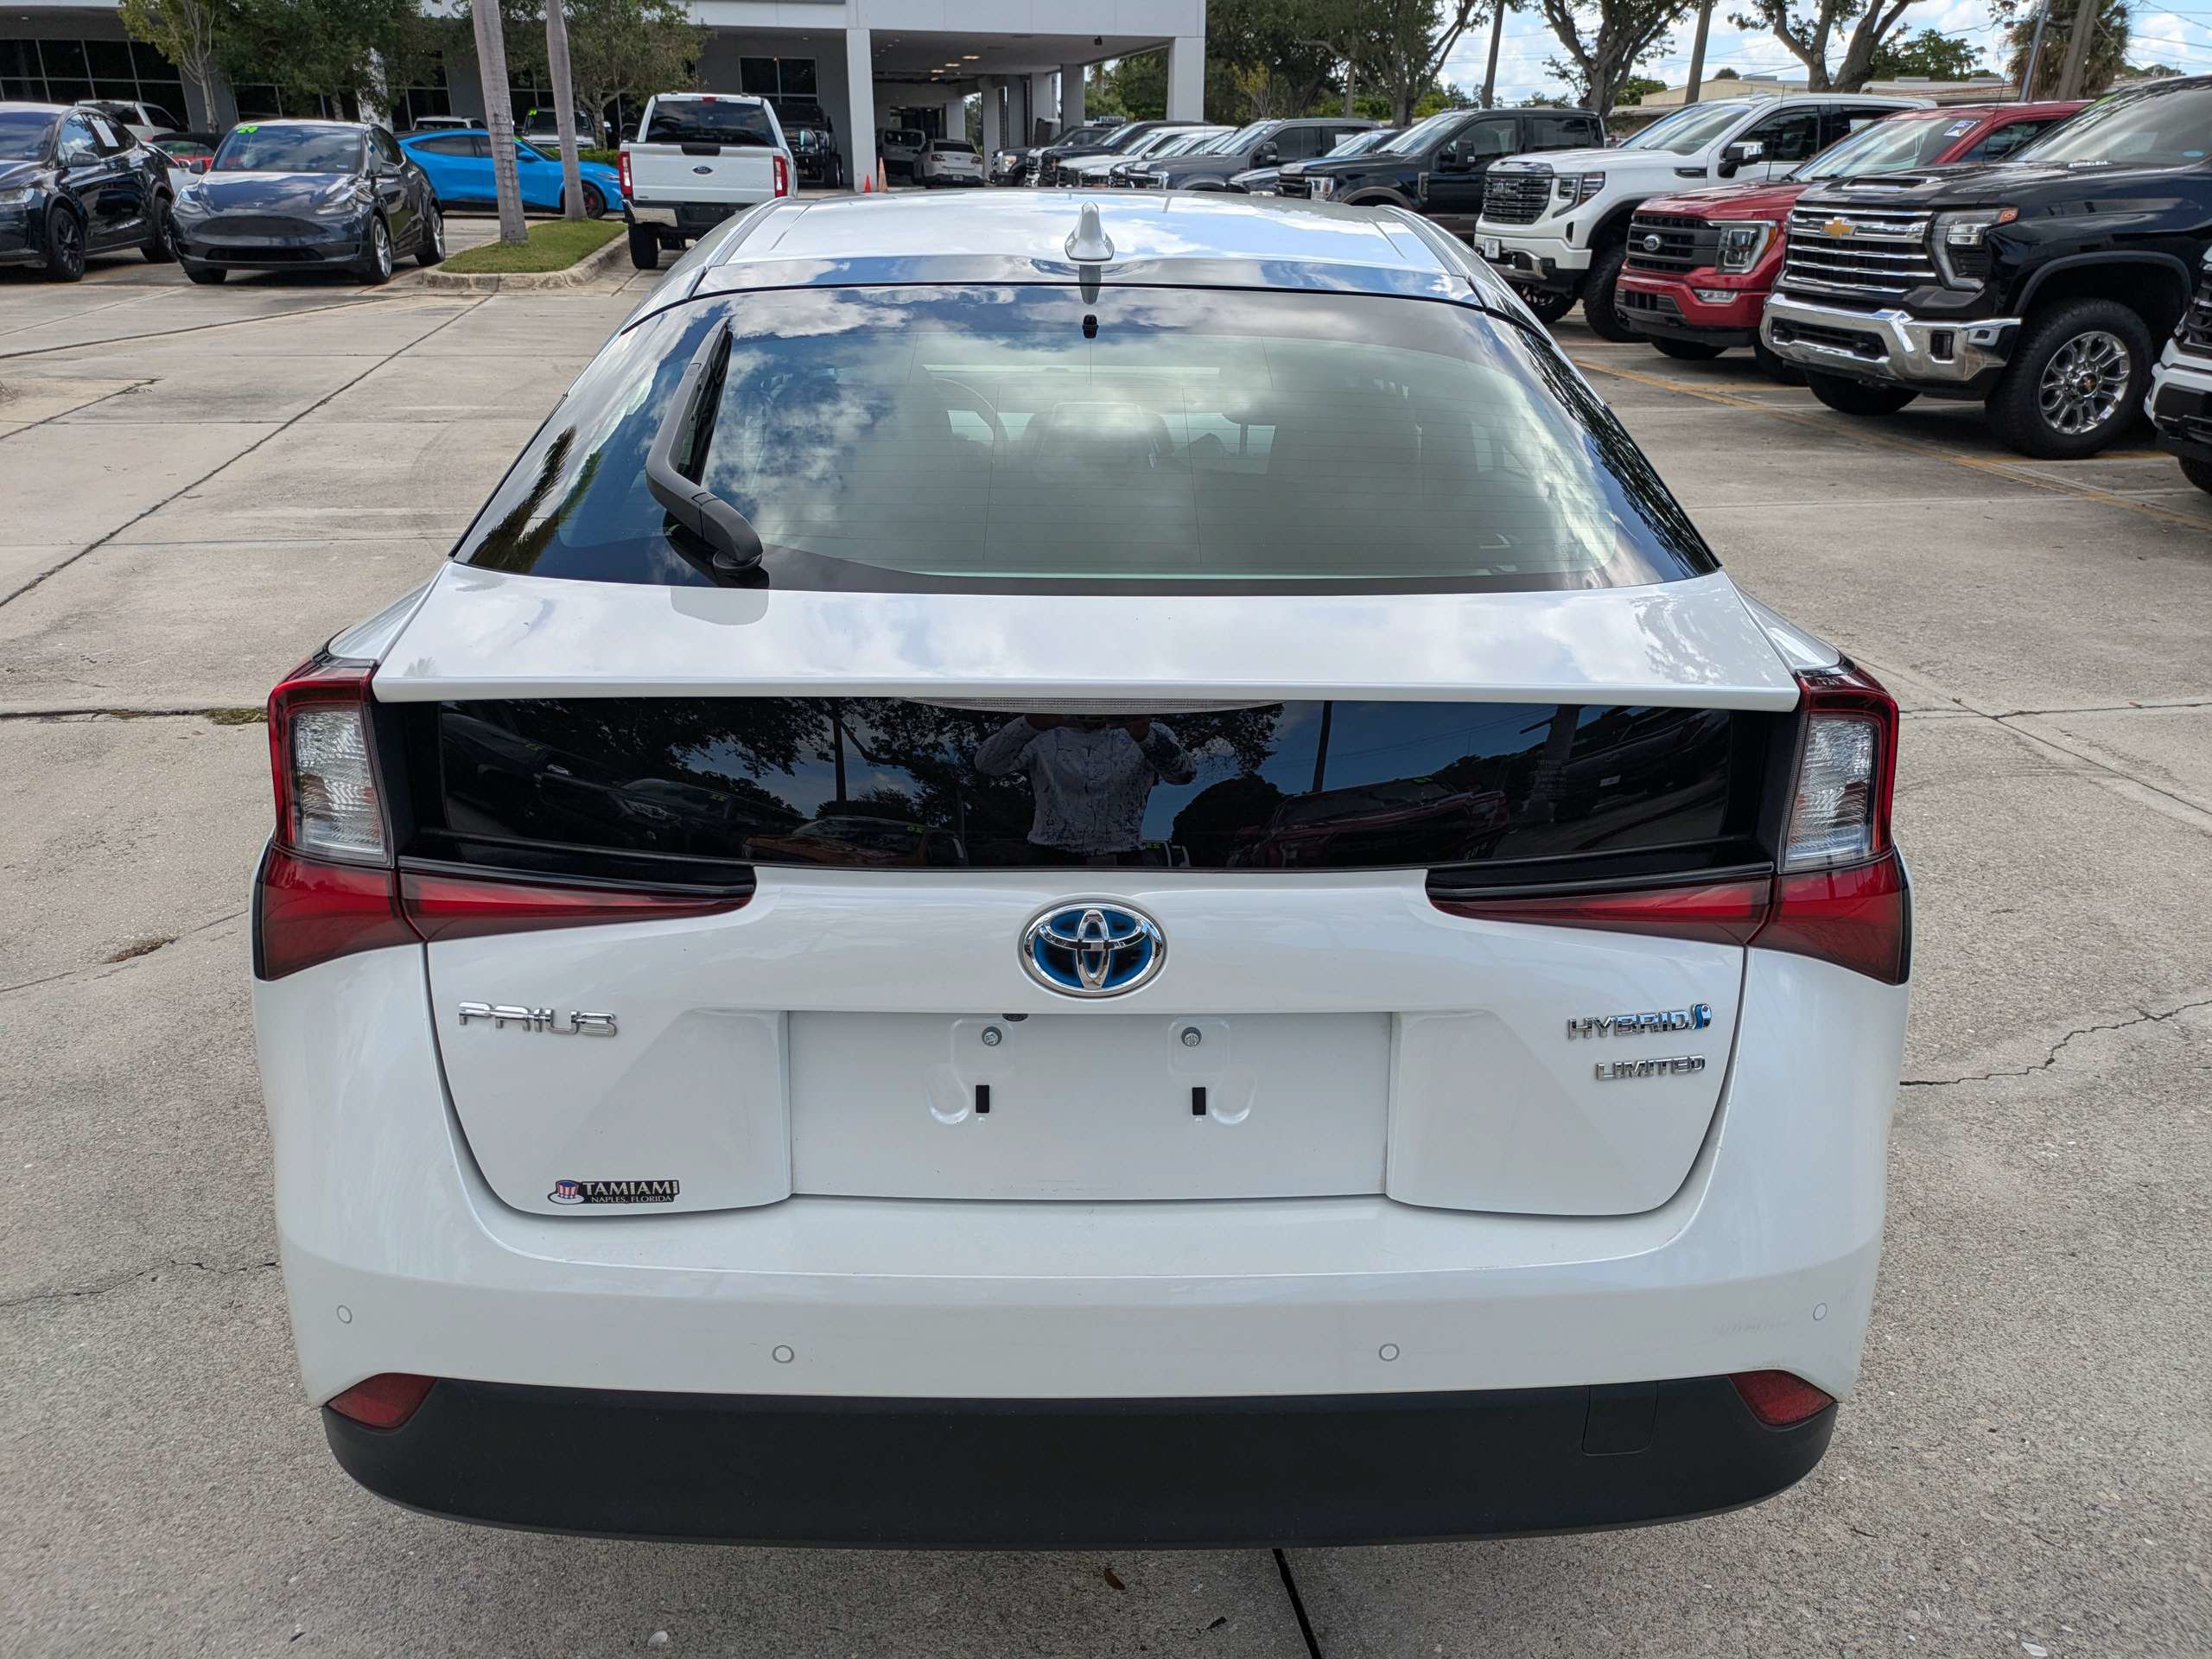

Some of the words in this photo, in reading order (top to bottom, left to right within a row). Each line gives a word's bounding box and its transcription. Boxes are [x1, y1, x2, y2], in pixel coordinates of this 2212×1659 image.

[459, 1001, 617, 1038] PRIUS
[1567, 1009, 1690, 1039] HYBRID
[1596, 1054, 1706, 1080] LIMITED
[582, 1180, 679, 1196] TAMIAMI
[591, 1195, 628, 1204] NAPLES,
